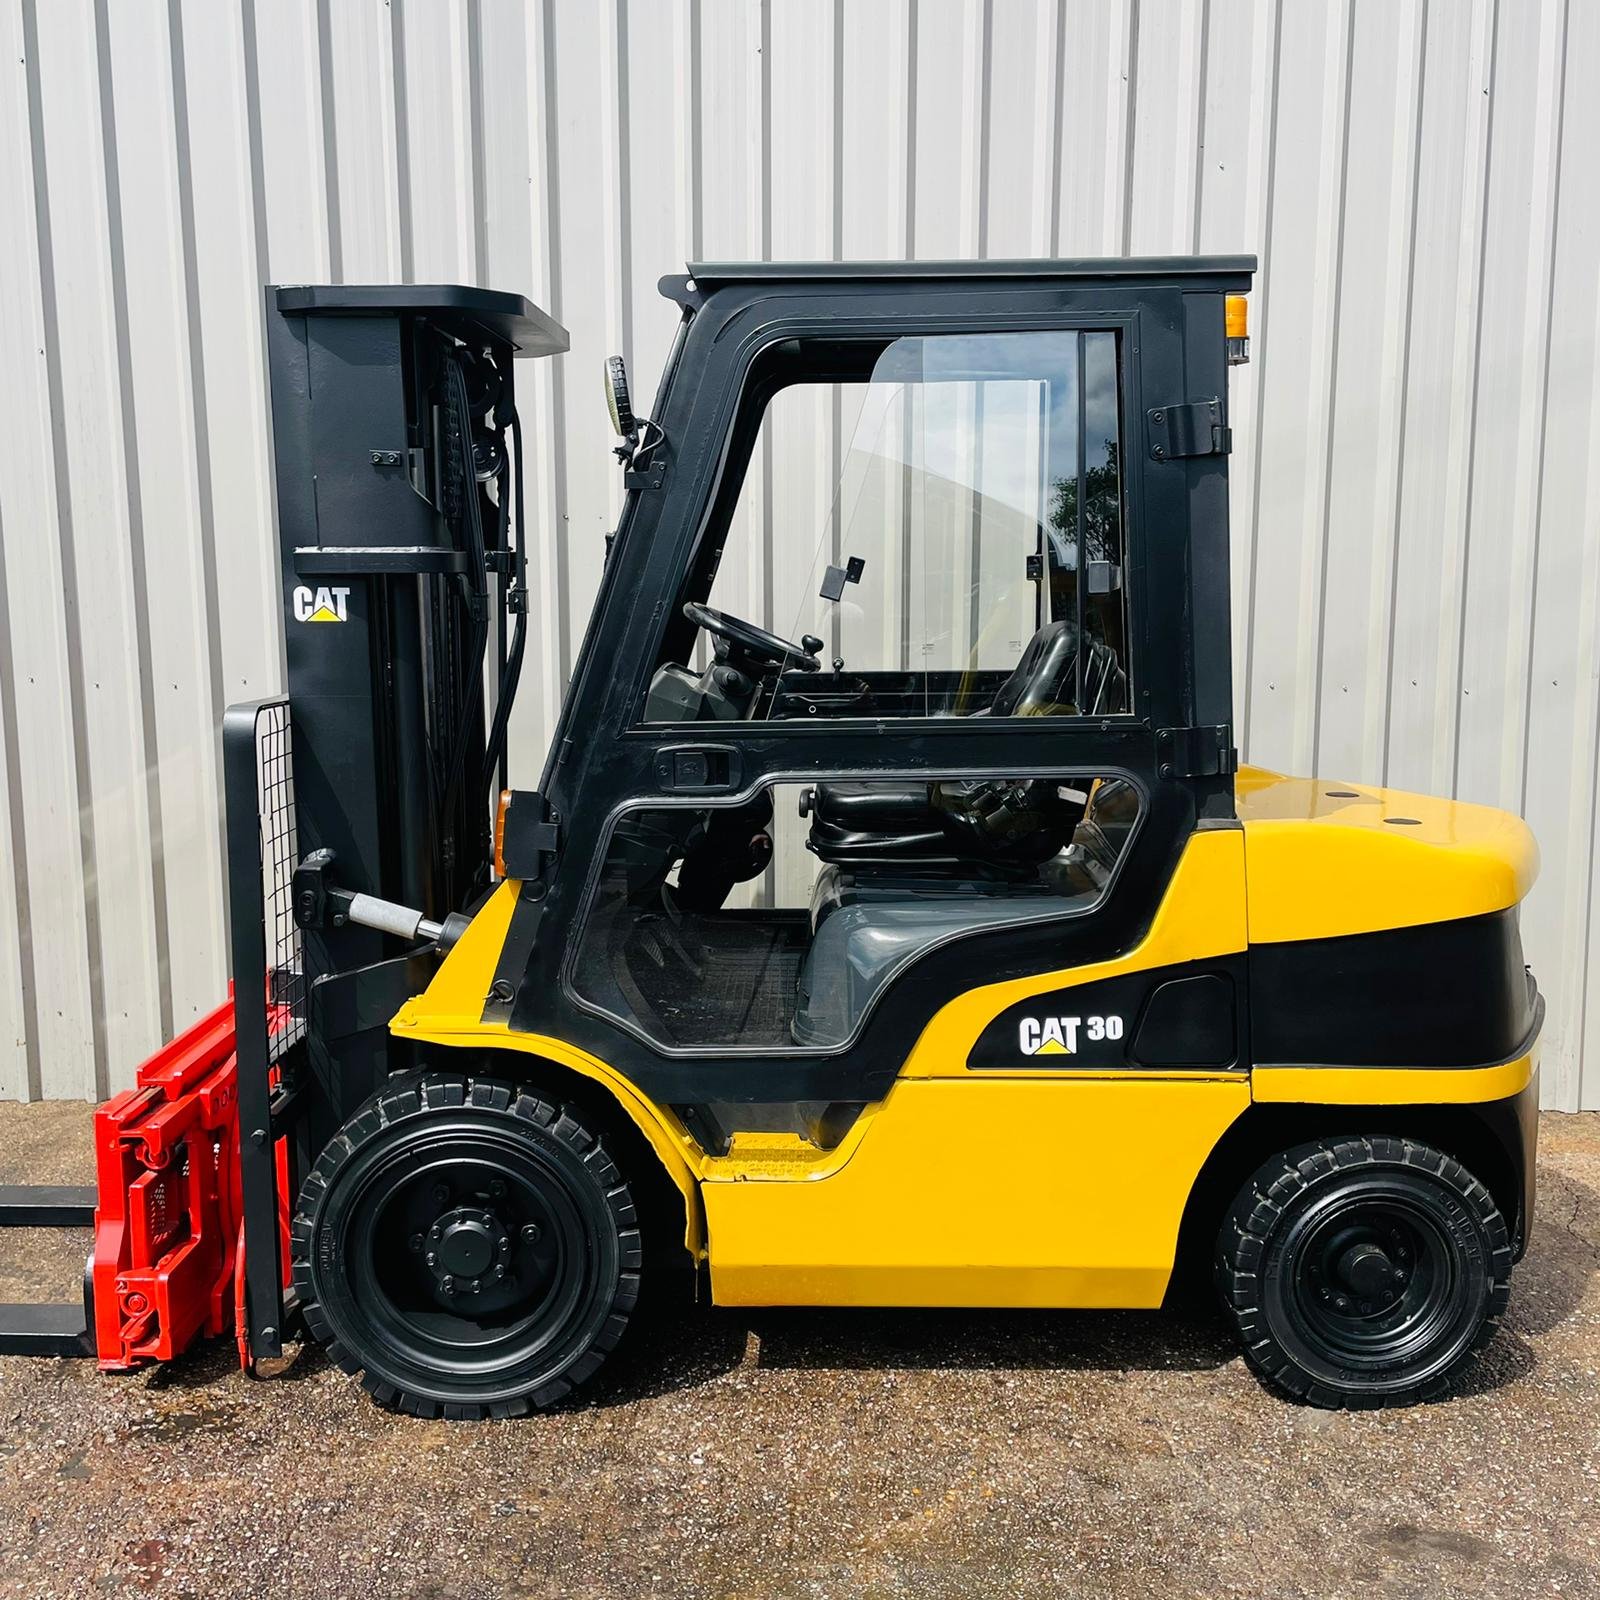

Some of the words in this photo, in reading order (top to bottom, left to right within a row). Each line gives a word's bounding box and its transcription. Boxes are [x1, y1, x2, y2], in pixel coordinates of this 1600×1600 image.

[293, 586, 350, 622] CAT
[1019, 1017, 1081, 1056] CAT
[1087, 1016, 1124, 1040] 30
[1438, 1191, 1482, 1265] SOLIDEAL
